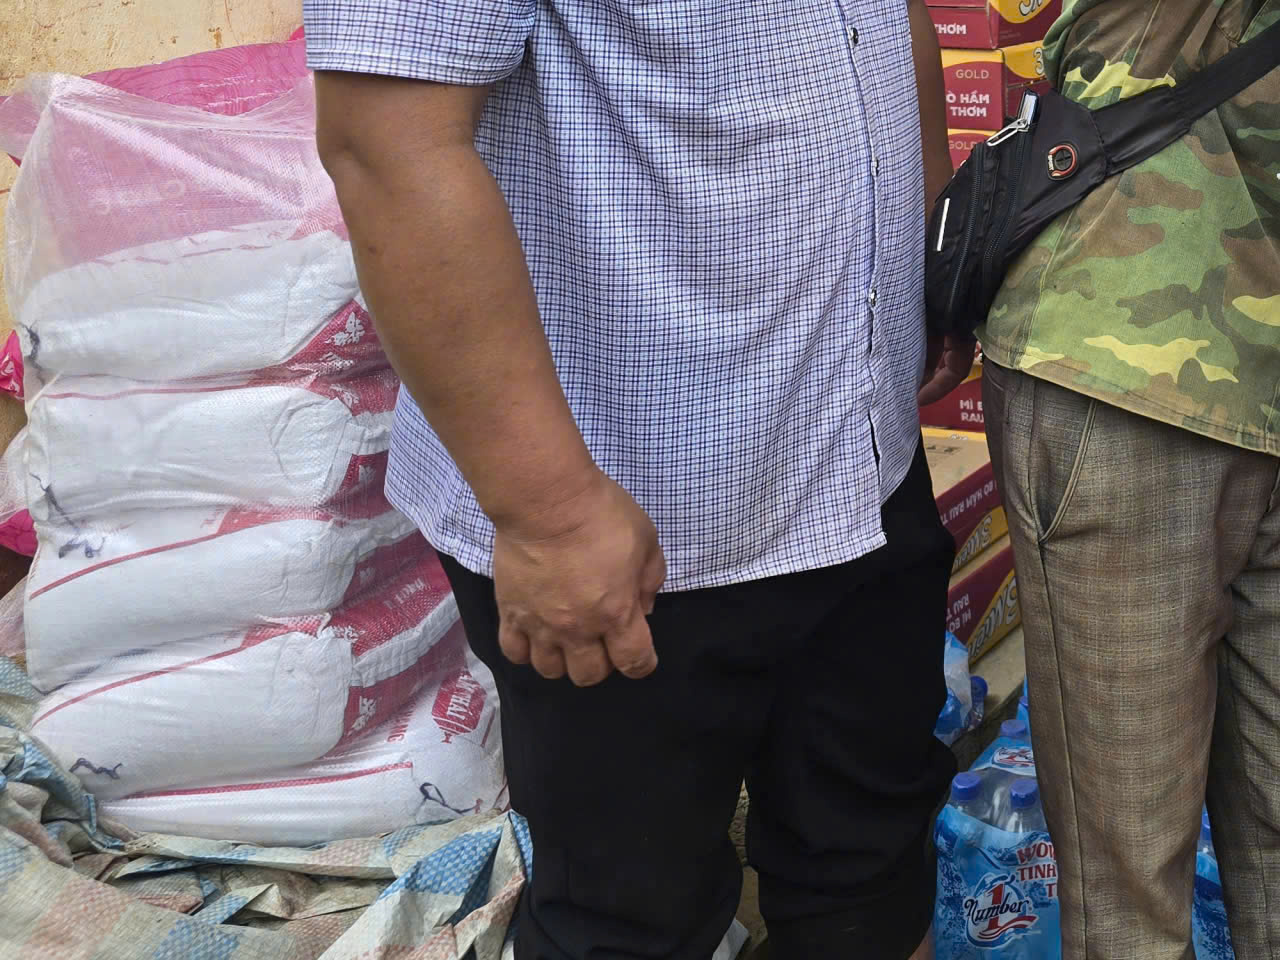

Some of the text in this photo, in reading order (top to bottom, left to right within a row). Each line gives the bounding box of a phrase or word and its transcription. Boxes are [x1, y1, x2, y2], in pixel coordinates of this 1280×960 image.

[956, 69, 989, 79] GOLD
[950, 106, 987, 117] THƠM
[964, 897, 1030, 926] Number
